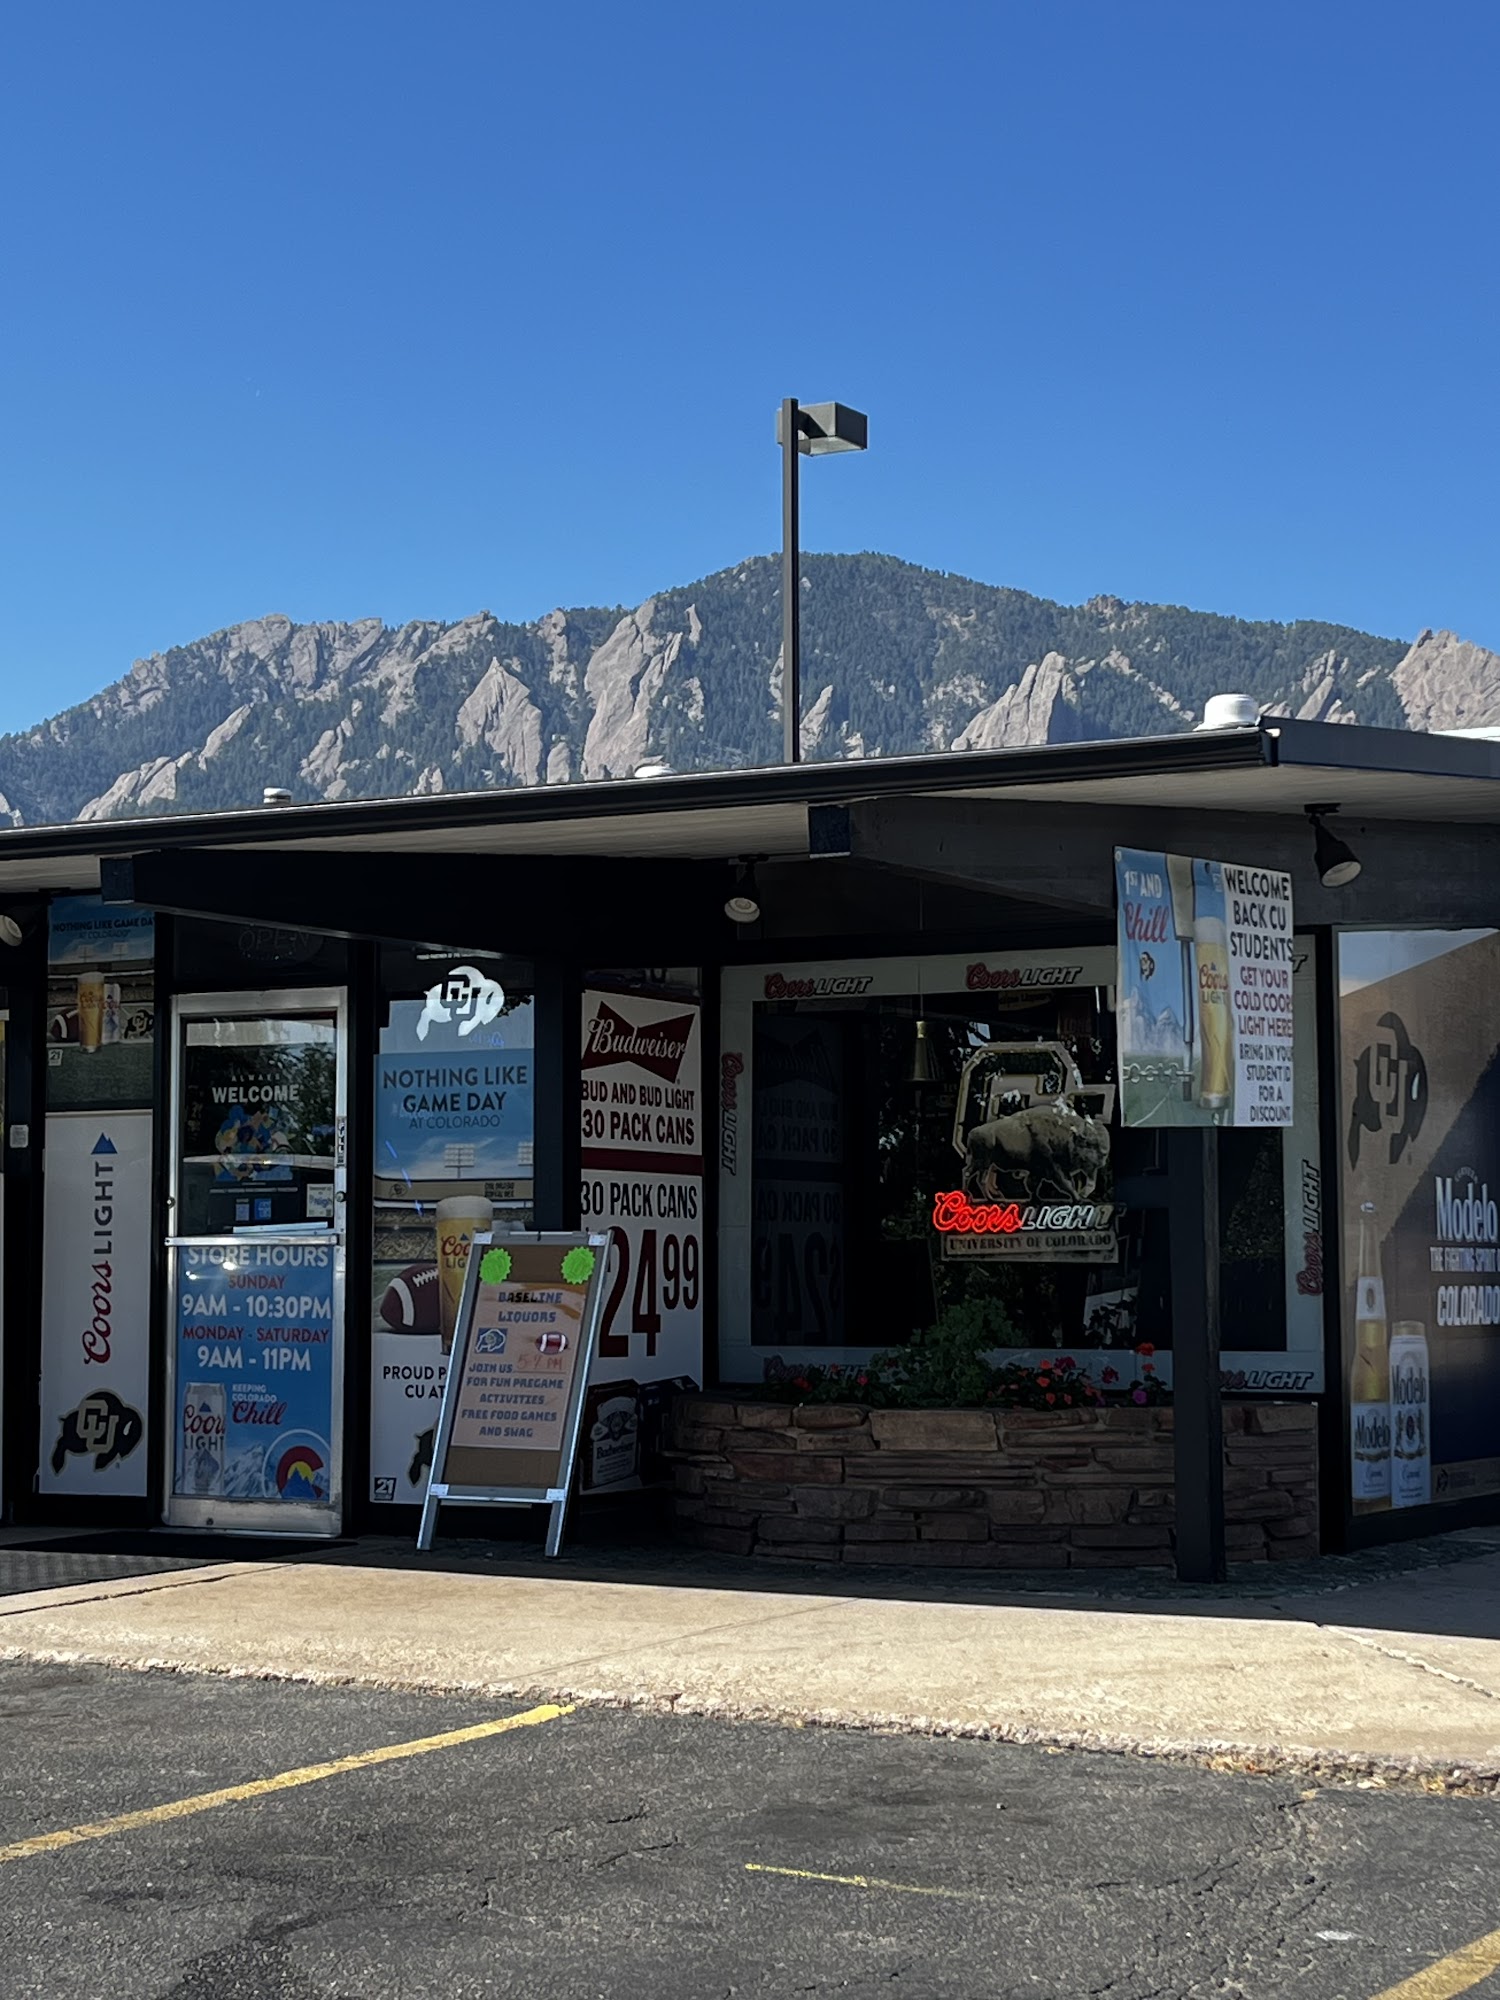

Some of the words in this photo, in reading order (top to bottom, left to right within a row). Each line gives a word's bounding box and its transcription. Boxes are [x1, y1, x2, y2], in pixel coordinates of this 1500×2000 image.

[1140, 873, 1162, 899] AND
[1224, 868, 1289, 901] WELCOME
[53, 919, 92, 931] NOTHING
[94, 919, 113, 930] LIKE
[114, 918, 140, 929] GAME
[1124, 902, 1169, 943] Chill
[1233, 900, 1267, 928] BACK
[1269, 905, 1286, 931] CU
[1230, 931, 1293, 962] STUDENTS
[764, 972, 815, 999] Coors
[814, 976, 872, 996] LIGHT
[966, 962, 1022, 990] Coors
[1020, 966, 1083, 986] LIGHT
[1199, 964, 1228, 990] Coors
[1240, 965, 1257, 986] GET
[1259, 967, 1288, 988] YOUR
[1234, 990, 1261, 1011] COLD
[1238, 1014, 1265, 1036] LIGHT
[1267, 1018, 1293, 1038] HERE
[588, 1018, 686, 1060] Budweiser
[1239, 1043, 1263, 1061] BRING
[1265, 1044, 1274, 1061] IN
[383, 1067, 478, 1088] NOTHING
[484, 1065, 527, 1085] LIKE
[722, 1052, 744, 1110] Coors
[1246, 1064, 1282, 1082] STUDENT
[212, 1084, 300, 1104] WELCOME
[403, 1093, 460, 1113] GAME
[467, 1091, 507, 1111] DAY
[581, 1080, 608, 1102] BUD
[611, 1082, 636, 1104] AND
[639, 1085, 662, 1107] BUD
[665, 1088, 694, 1111] LIGHT
[1258, 1085, 1275, 1102] FOR
[1276, 1086, 1284, 1102] A
[408, 1117, 423, 1129] AT
[426, 1115, 501, 1129] COLORADO
[1250, 1105, 1291, 1122] DISCOUNT
[582, 1108, 605, 1138] 30
[610, 1111, 652, 1143] PACK
[656, 1115, 695, 1146] CANS
[721, 1109, 737, 1176] LIGHT
[94, 1160, 113, 1255] LIGHT
[581, 1180, 604, 1215] 30
[610, 1182, 653, 1217] PACK
[657, 1183, 698, 1219] CANS
[1302, 1159, 1320, 1233] LIGHT
[932, 1190, 1022, 1234] Coors
[1020, 1204, 1115, 1231] LIGHT
[1435, 1176, 1499, 1243] Modelo
[441, 1234, 472, 1257] Coo
[950, 1237, 1022, 1250] UNIVERSITY
[1027, 1237, 1040, 1248] OF
[1045, 1234, 1112, 1248] COLORADO
[188, 1246, 250, 1267] STORE
[256, 1246, 329, 1268] HOURS
[446, 1257, 466, 1269] LIG
[1296, 1231, 1324, 1296] Coors
[228, 1273, 286, 1290] SUNDAY
[181, 1294, 227, 1317] 9AM
[246, 1295, 331, 1320] 10:30PM
[498, 1292, 563, 1304] BASELINE
[1437, 1285, 1500, 1327] COLORADO
[82, 1260, 112, 1364] Coors
[498, 1311, 556, 1323] LIQUORS
[183, 1325, 244, 1341] MONDAY
[256, 1327, 329, 1344] SATURDAY
[197, 1346, 242, 1369] 9AM
[262, 1348, 311, 1371] 11PM
[469, 1363, 498, 1374] JOIN
[499, 1364, 513, 1374] US
[547, 1357, 563, 1371] PM
[383, 1366, 434, 1380] PROUD
[466, 1376, 488, 1387] FOR
[489, 1377, 511, 1388] FUN
[513, 1378, 564, 1389] PREGAME
[1245, 1370, 1314, 1390] LIGHT
[1392, 1364, 1427, 1405] Modelo
[231, 1393, 278, 1403] COLORADO
[232, 1383, 267, 1393] KEEPING
[404, 1384, 425, 1399] CU
[479, 1393, 545, 1405] ACTIVITIES
[183, 1404, 225, 1434] Coor
[232, 1401, 288, 1425] Chill
[461, 1409, 488, 1420] FREE
[490, 1410, 519, 1421] FOOD
[520, 1411, 557, 1422] GAMES
[479, 1426, 502, 1437] AND
[503, 1427, 533, 1438] SWAG
[1355, 1415, 1391, 1449] Modelo
